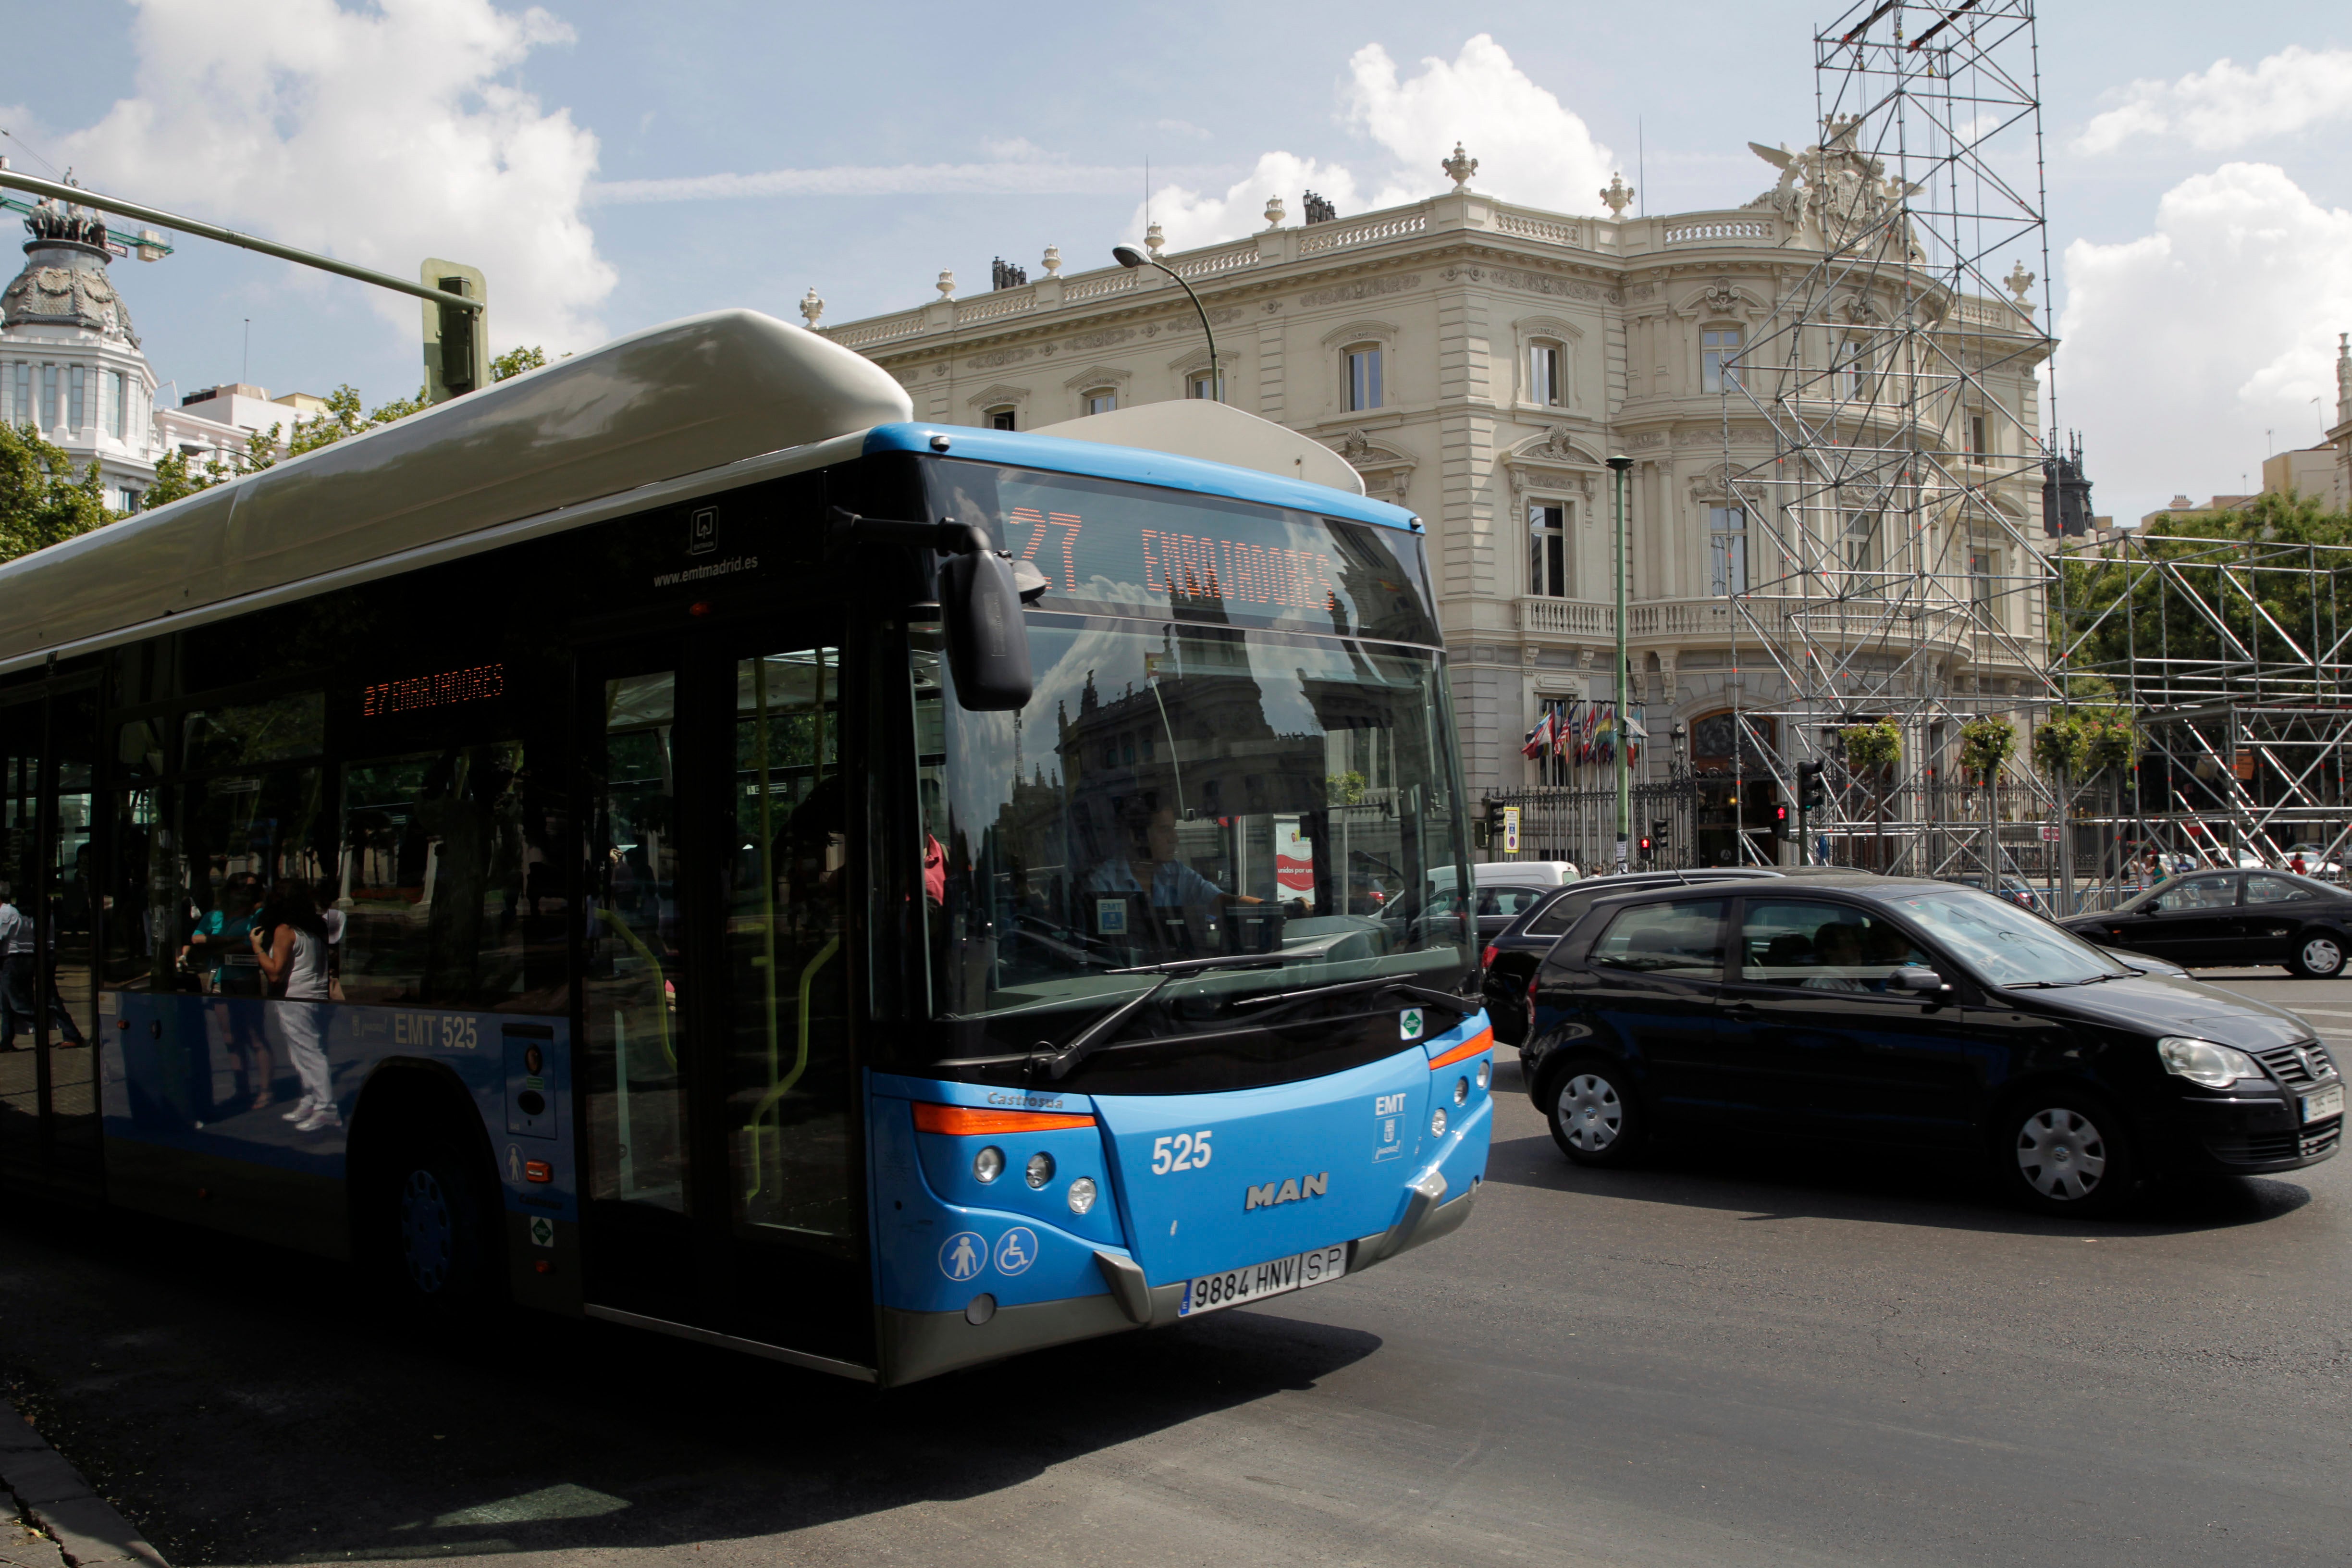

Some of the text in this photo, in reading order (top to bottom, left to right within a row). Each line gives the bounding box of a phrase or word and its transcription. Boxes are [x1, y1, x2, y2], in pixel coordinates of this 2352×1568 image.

[653, 555, 758, 588] www.emtmadrid.es
[1010, 507, 1334, 611] 27 EMBAJADORES
[364, 664, 503, 716] 27 EMBAJADORES
[394, 1013, 436, 1047] EMT
[442, 1016, 477, 1049] 525
[987, 1091, 1063, 1109] Castrosua
[1375, 1093, 1406, 1116] EMT
[1151, 1130, 1212, 1175] 525
[1245, 1171, 1329, 1210] MAN
[1195, 1270, 1249, 1308] 9884
[1256, 1258, 1295, 1294] HNV
[1307, 1247, 1342, 1281] SP
